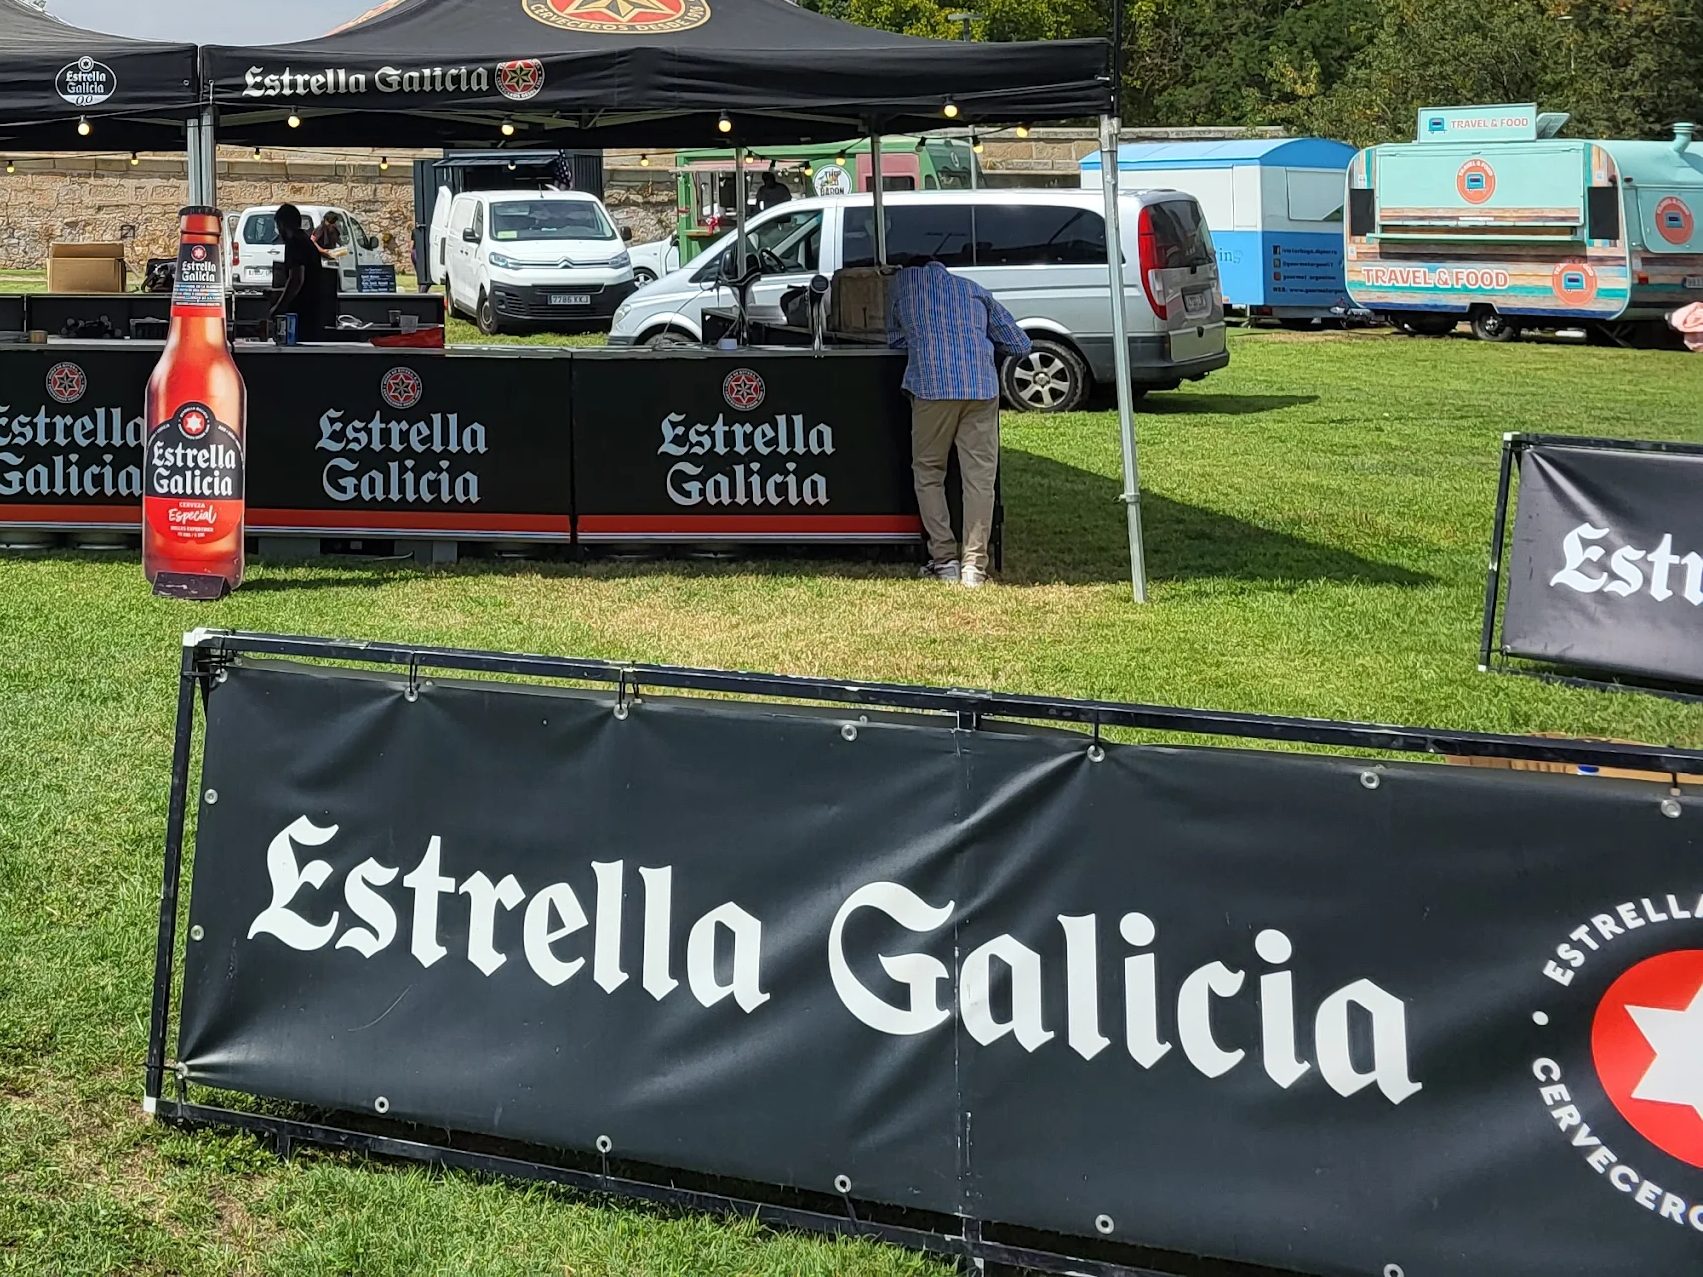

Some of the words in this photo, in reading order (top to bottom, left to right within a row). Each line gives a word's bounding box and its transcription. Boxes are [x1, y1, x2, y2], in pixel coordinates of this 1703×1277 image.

[530, 3, 629, 31] CERVECEROS
[636, 18, 690, 31] DESDE
[66, 71, 106, 82] Estrella
[67, 82, 104, 93] Galicia
[241, 65, 367, 97] Estrella
[374, 66, 490, 94] Galicia
[1451, 119, 1488, 129] TRAVEL
[1491, 119, 1498, 127] &
[1500, 118, 1529, 127] FOOD
[182, 261, 216, 272] Estrella
[182, 271, 215, 282] Galicia
[1362, 267, 1433, 287] TRAVEL
[1436, 268, 1451, 287] &
[1453, 269, 1509, 290] FOOD
[315, 408, 489, 454] Estrella
[657, 412, 836, 456] Estrella
[152, 440, 236, 469] Estrella
[153, 467, 233, 496] Galicia
[322, 457, 481, 504] Galicia
[666, 461, 830, 506] Galicia
[168, 505, 217, 524] Especial
[247, 815, 771, 1014] Estrella
[828, 881, 1423, 1105] Galicia
